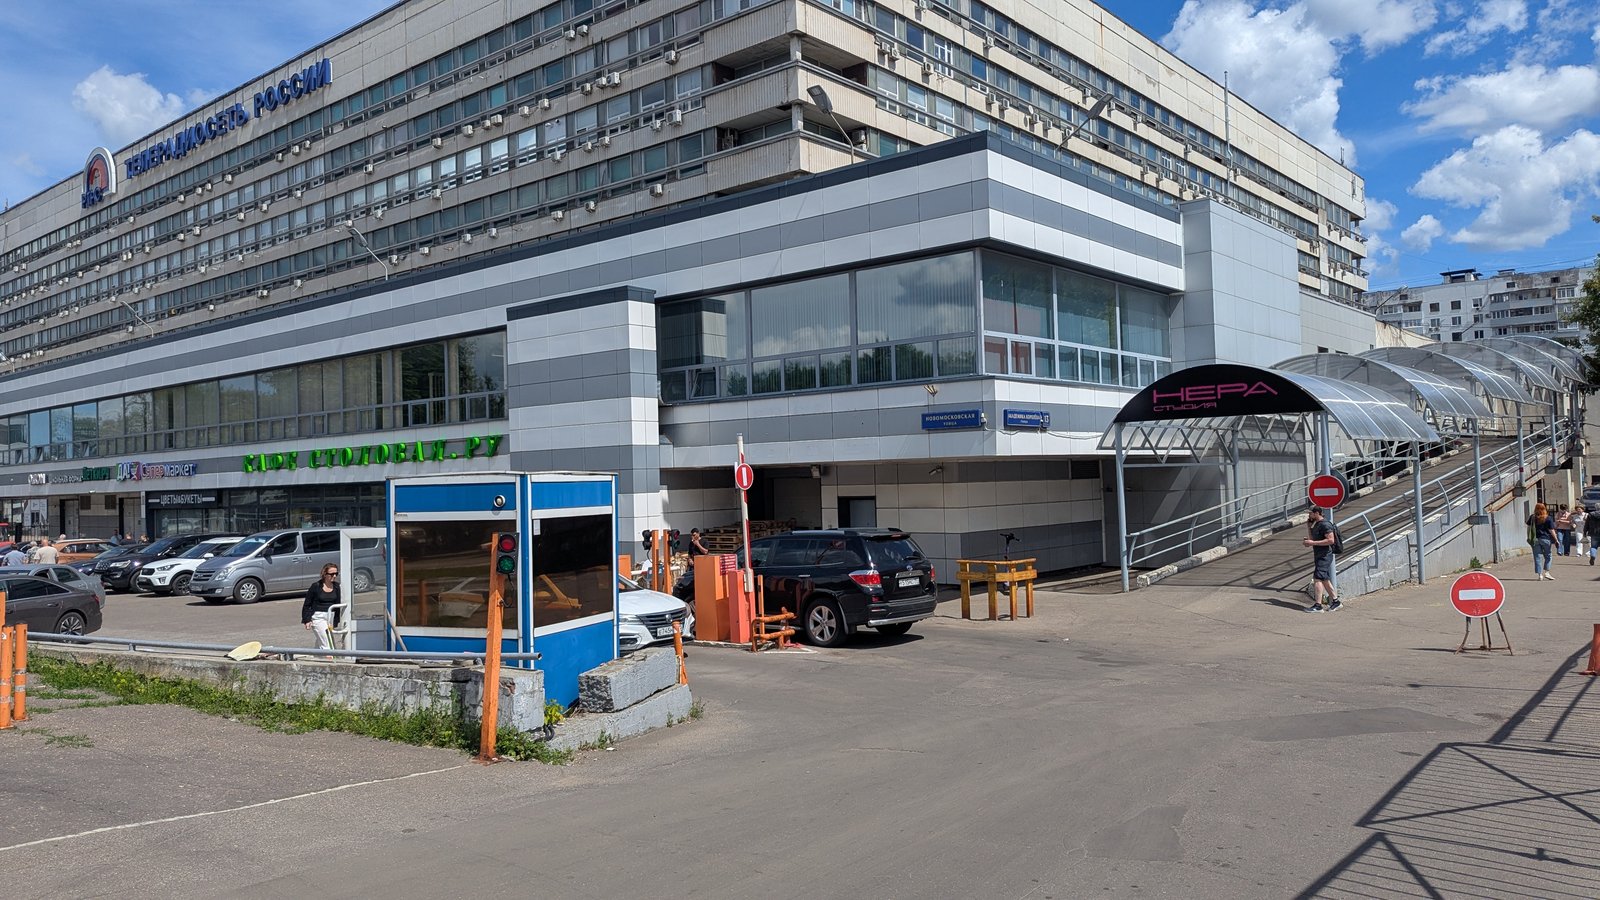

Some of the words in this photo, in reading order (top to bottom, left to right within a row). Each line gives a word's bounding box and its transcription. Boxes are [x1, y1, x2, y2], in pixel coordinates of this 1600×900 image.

[124, 102, 249, 179] ТЕЛЕРАДИОСЕТЬ
[253, 58, 333, 119] РОССИИ
[1152, 381, 1278, 404] НЕРА
[925, 413, 976, 422] НОВОМОСКОВСКАЯ
[142, 462, 196, 479] Супермаркет
[243, 451, 299, 473] КАФЕ
